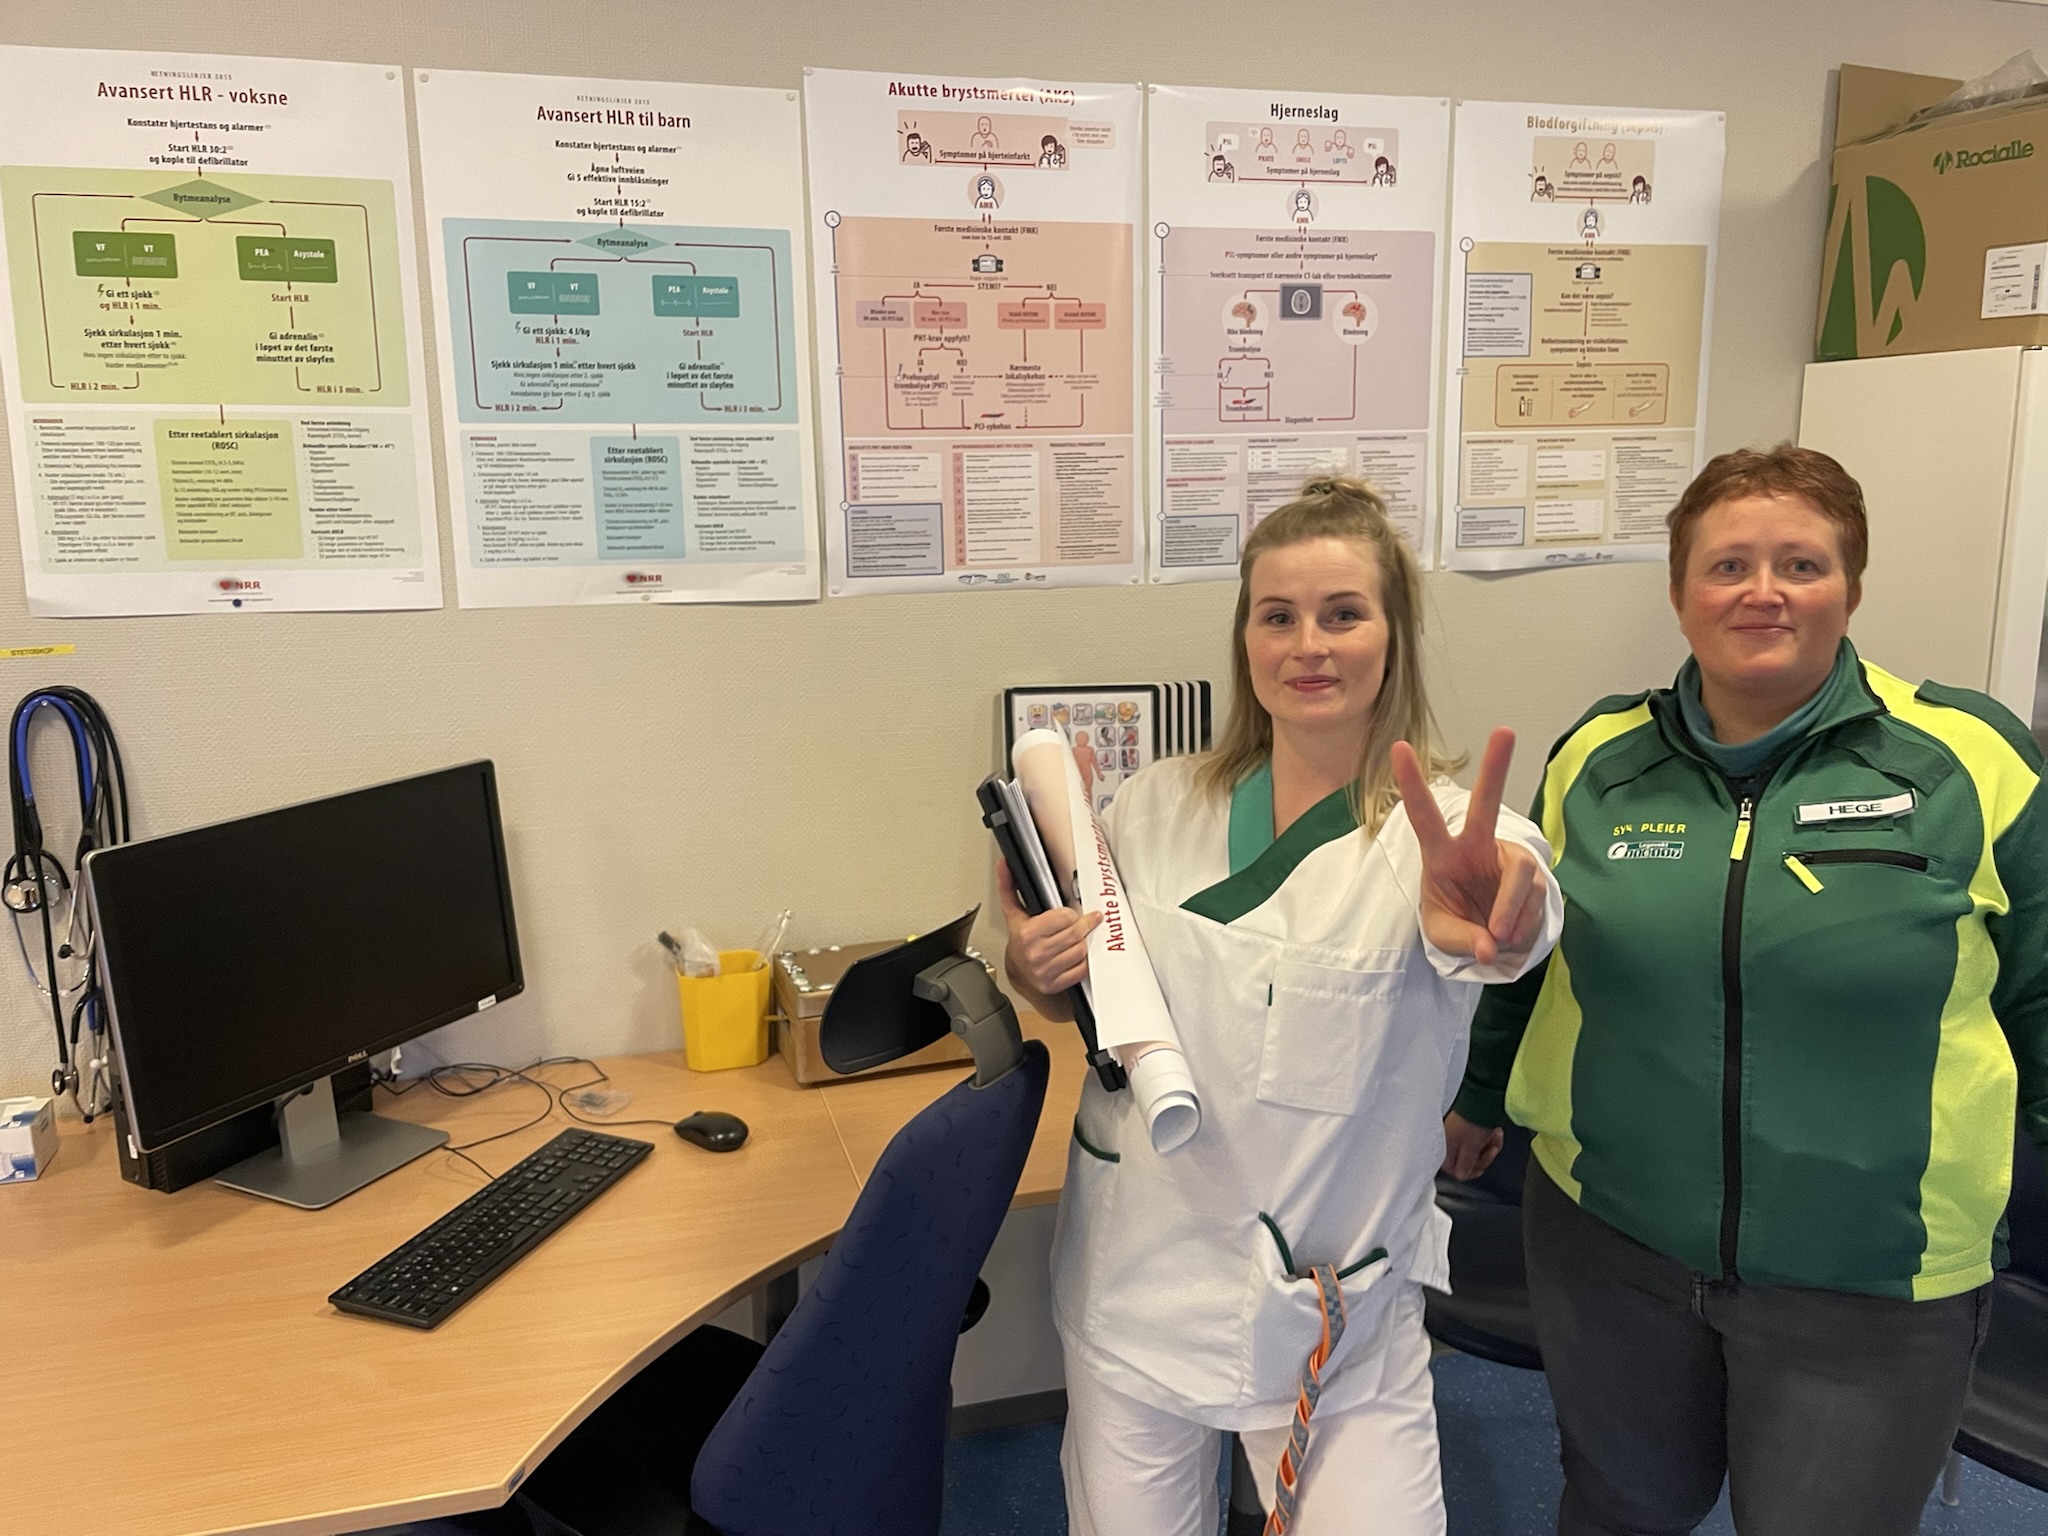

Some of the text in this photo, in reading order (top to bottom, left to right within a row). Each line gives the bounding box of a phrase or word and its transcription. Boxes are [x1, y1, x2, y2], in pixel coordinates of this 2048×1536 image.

[97, 83, 173, 100] Avansert
[179, 85, 212, 101] HLR
[229, 88, 287, 105] voksne
[888, 82, 937, 97] Akutte
[942, 85, 1034, 102] brystsmerter
[537, 107, 690, 128] Avansert HLR til barn
[1270, 103, 1338, 122] Hjerneslag
[127, 118, 168, 127] Konstater
[168, 120, 217, 130] hjertestans
[219, 124, 230, 132] og
[168, 144, 226, 154] Start HLR 30:2
[555, 140, 592, 149] Konstater
[592, 142, 636, 151] hjertestans
[939, 150, 1030, 161] Symptomer på hjerteinfarkt
[1955, 140, 2035, 169] Rocialle
[149, 156, 160, 164] og
[161, 155, 184, 164] kople
[197, 156, 248, 166] defibrillator
[591, 163, 645, 174] Åpne luftveien
[1266, 166, 1300, 175] Symptomer
[1309, 168, 1340, 176] hjerneslag
[583, 174, 616, 182] effektive
[618, 176, 668, 186] innblåsninger
[173, 193, 231, 204] Rytmeanalyse
[586, 207, 608, 216] kople
[620, 208, 664, 216] defibrillator
[596, 238, 648, 248] Rytmeanalyse
[254, 248, 270, 256] PEA
[105, 289, 114, 297] Gi
[130, 290, 153, 300] sjokk
[84, 328, 106, 338] Sjekk
[108, 329, 154, 338] sirkulasjon
[544, 328, 566, 336] sjokk:
[574, 328, 590, 337] J/kg
[148, 341, 170, 350] sjokk
[259, 343, 281, 352] løpet
[305, 355, 334, 364] sløyfen
[491, 360, 512, 369] Sjekk
[511, 361, 552, 369] sirkulasjon
[617, 362, 636, 371] sjokk
[234, 431, 278, 440] sirkulasjon
[211, 442, 238, 450] (ROSC)
[235, 581, 260, 589] NRR
[10, 647, 54, 656] STETOSKOP
[1828, 802, 1883, 815] HEGE
[1640, 823, 1686, 833] PLEIER
[1104, 900, 1126, 951] Akutte
